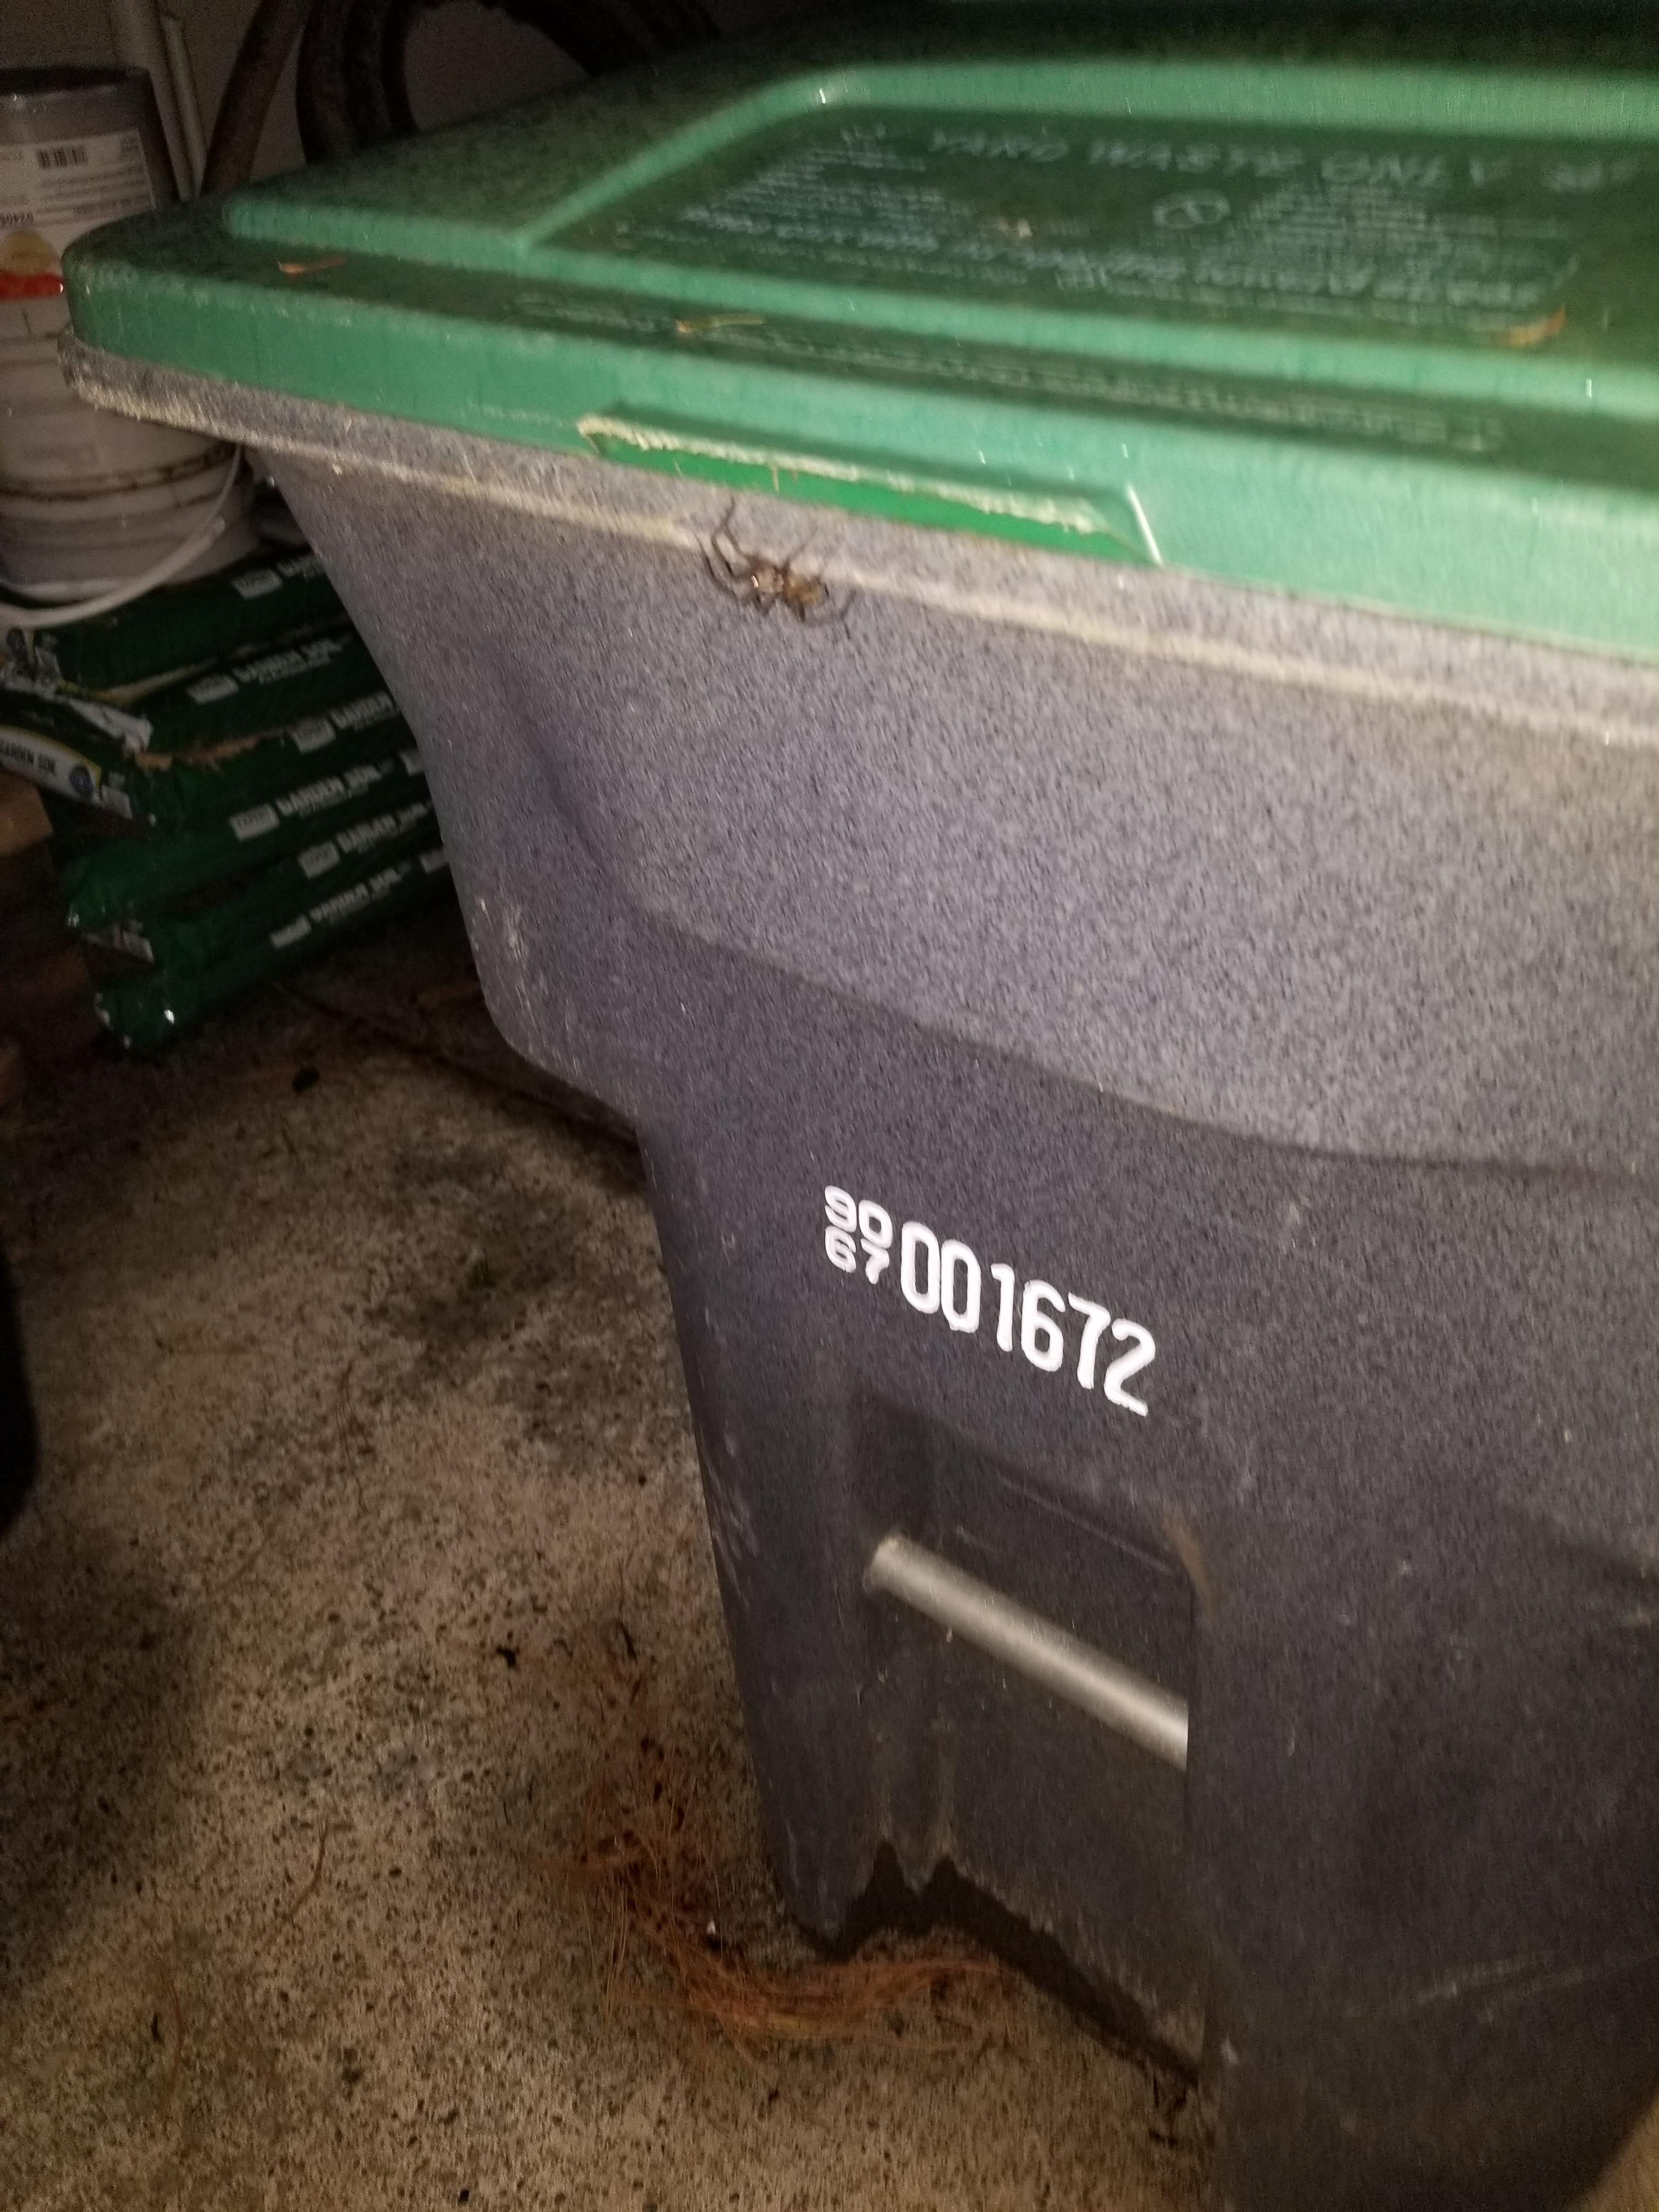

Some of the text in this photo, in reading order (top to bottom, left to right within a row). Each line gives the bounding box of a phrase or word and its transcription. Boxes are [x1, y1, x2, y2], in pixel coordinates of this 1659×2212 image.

[824, 1185, 893, 1249] 90
[825, 1225, 890, 1284] 67
[900, 1221, 1156, 1417] 001672
